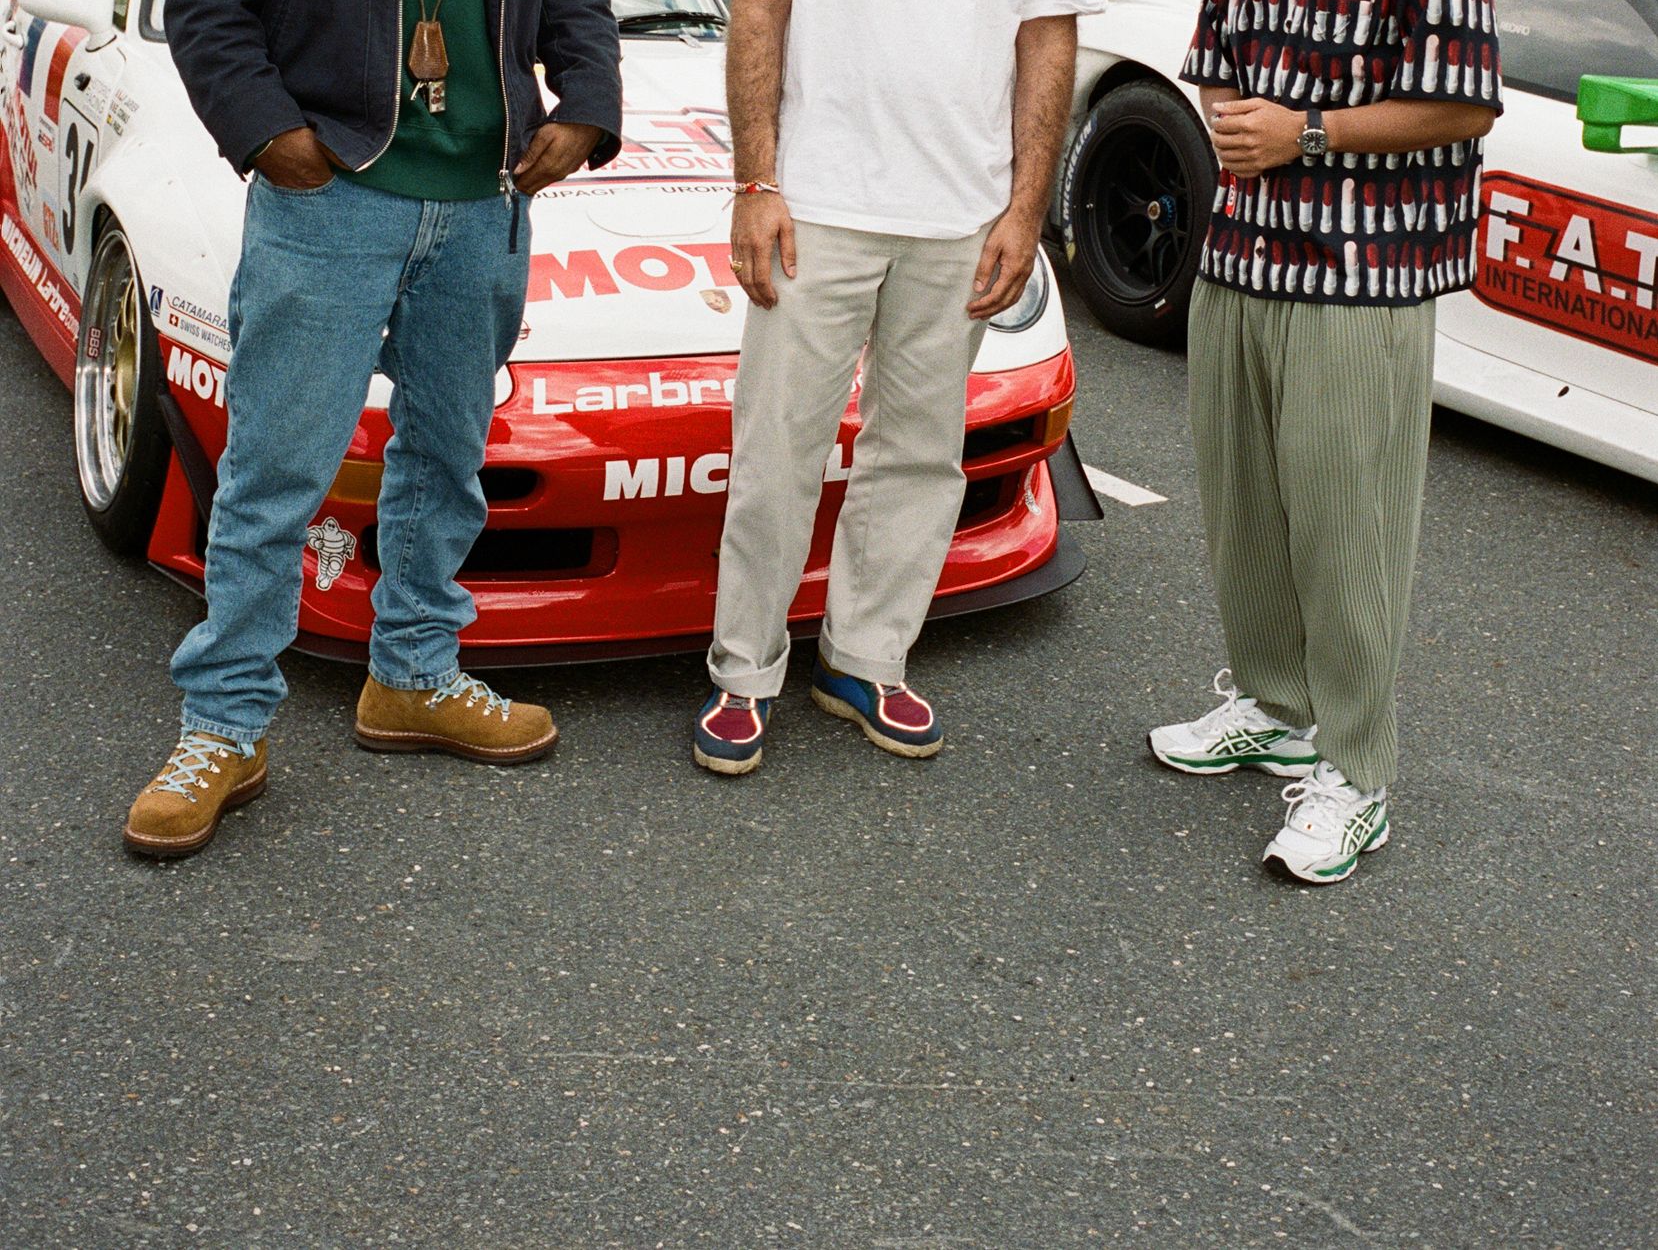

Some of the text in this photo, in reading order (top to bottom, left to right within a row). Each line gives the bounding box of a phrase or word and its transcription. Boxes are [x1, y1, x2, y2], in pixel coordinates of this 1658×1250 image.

[1063, 119, 1092, 221] MICHELIN
[2, 213, 43, 285] MICHELIN
[171, 296, 229, 330] CATAMARA
[88, 327, 101, 357] BBS
[180, 319, 231, 352] SWISS WATCHES
[532, 372, 735, 415] Larbr
